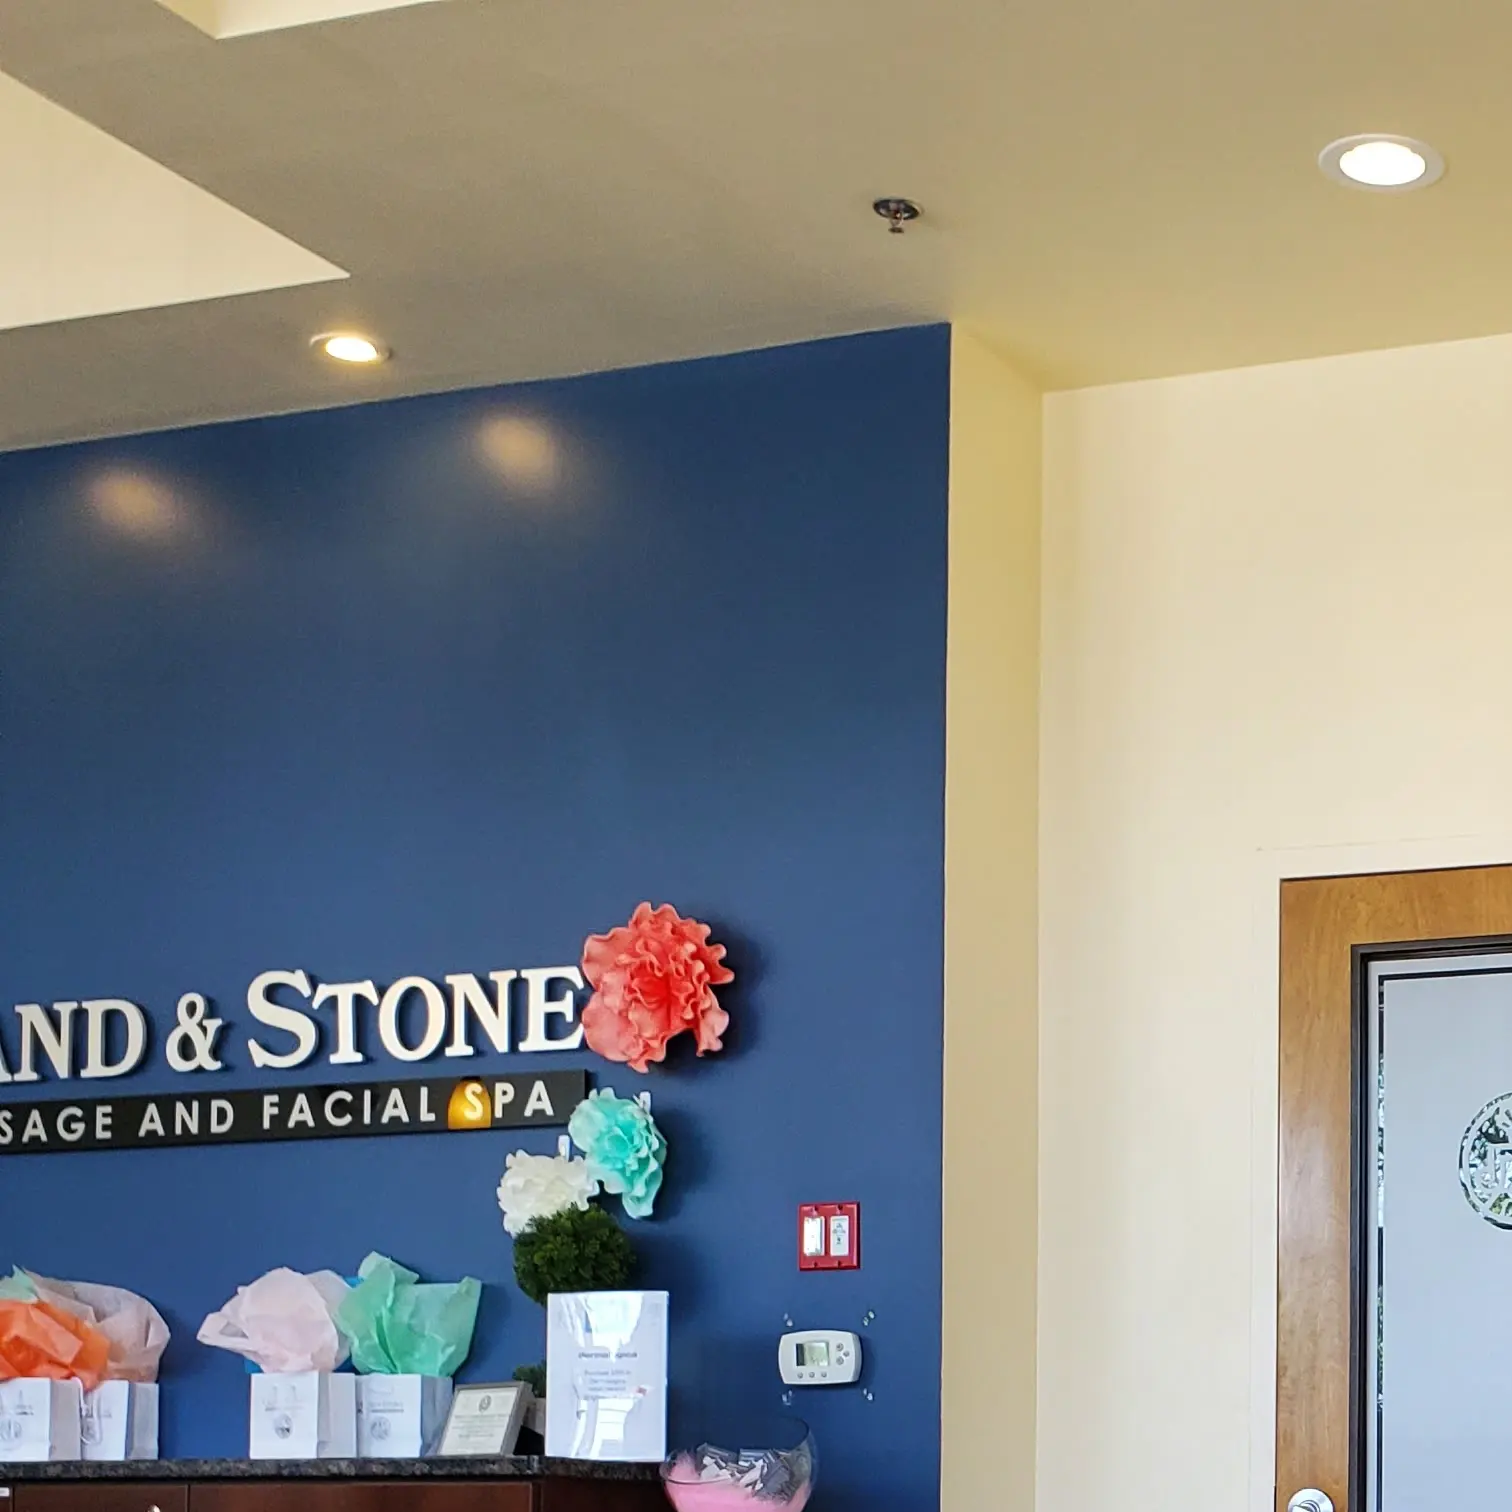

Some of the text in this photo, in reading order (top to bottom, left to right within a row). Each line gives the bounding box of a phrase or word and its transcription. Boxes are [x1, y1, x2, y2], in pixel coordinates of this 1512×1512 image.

[166, 992, 222, 1072] &
[248, 966, 585, 1068] STONE
[0, 1080, 554, 1144] SAGE AND FACIAL SPA
